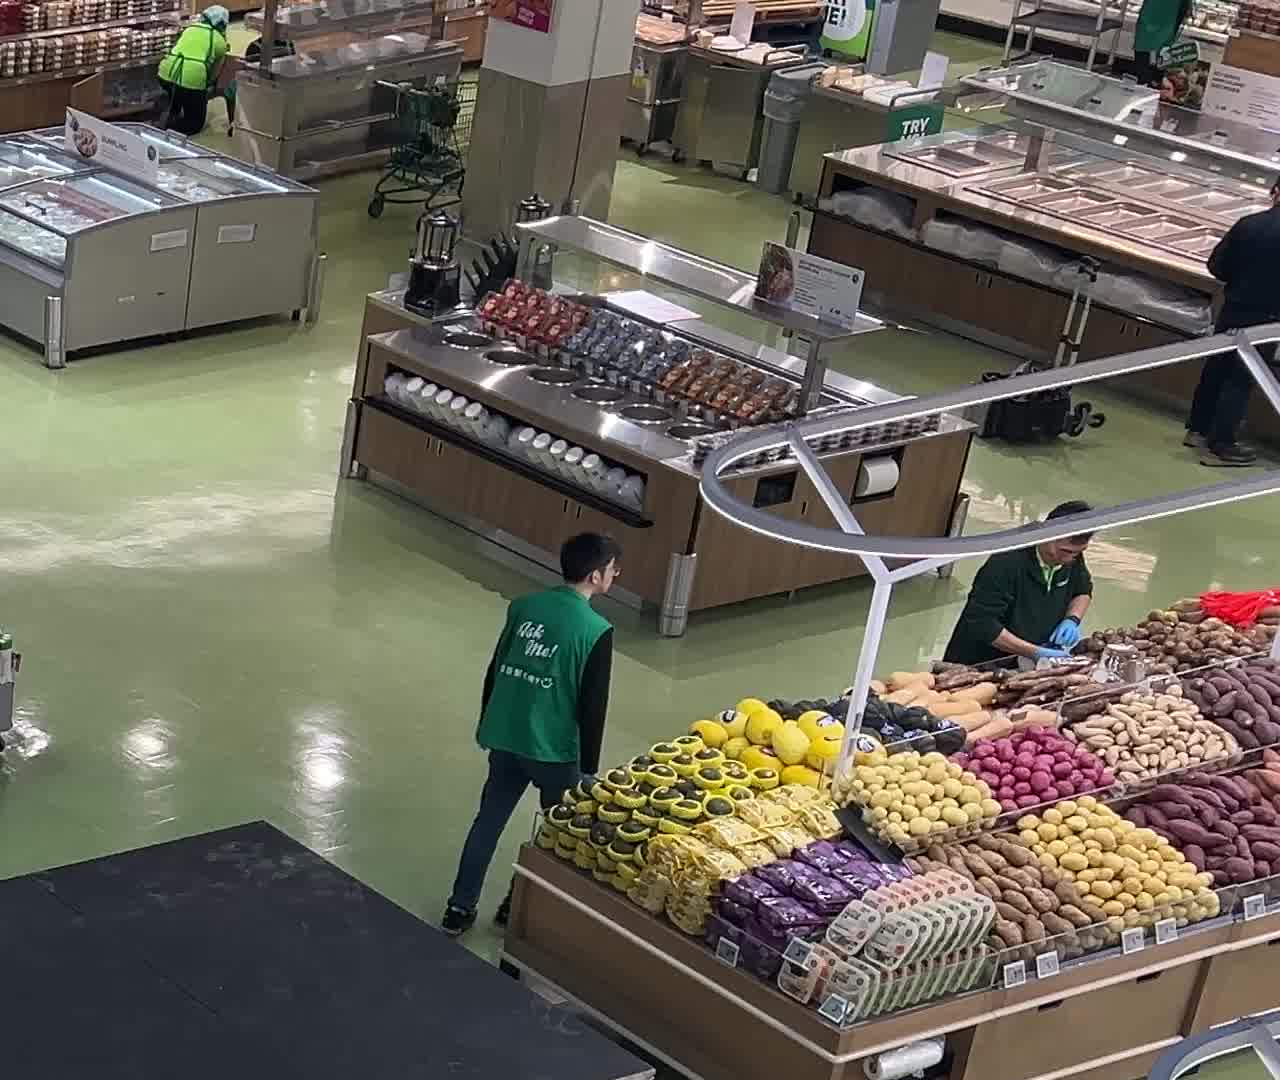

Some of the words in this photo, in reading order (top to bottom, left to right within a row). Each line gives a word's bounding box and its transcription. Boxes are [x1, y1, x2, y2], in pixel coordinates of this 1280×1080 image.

[902, 117, 930, 135] TRY
[517, 620, 545, 639] Ask
[524, 639, 559, 658] Me!
